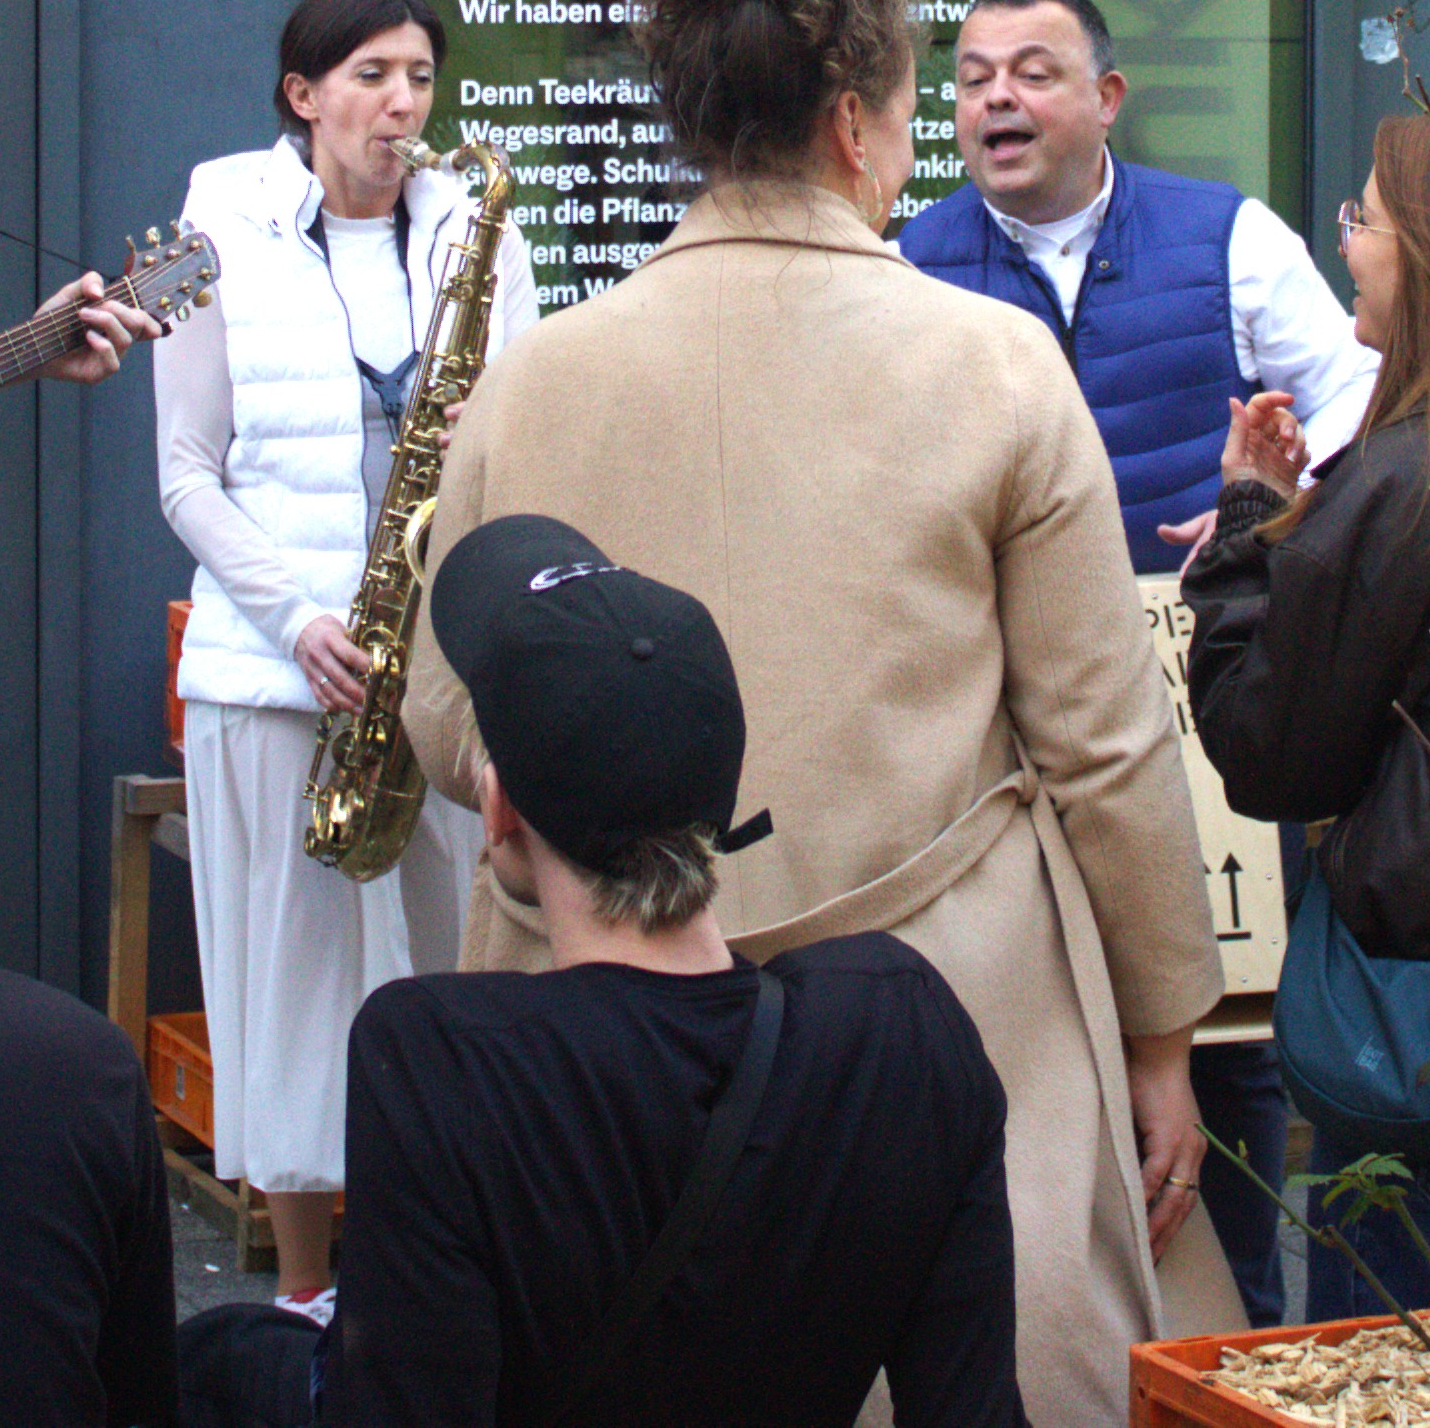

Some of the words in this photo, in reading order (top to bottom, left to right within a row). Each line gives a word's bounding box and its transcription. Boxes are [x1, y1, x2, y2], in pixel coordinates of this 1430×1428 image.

[460, 79, 533, 107] Denn
[459, 119, 627, 152] Wegesrand,
[553, 198, 596, 225] die
[572, 242, 662, 270] ausge
